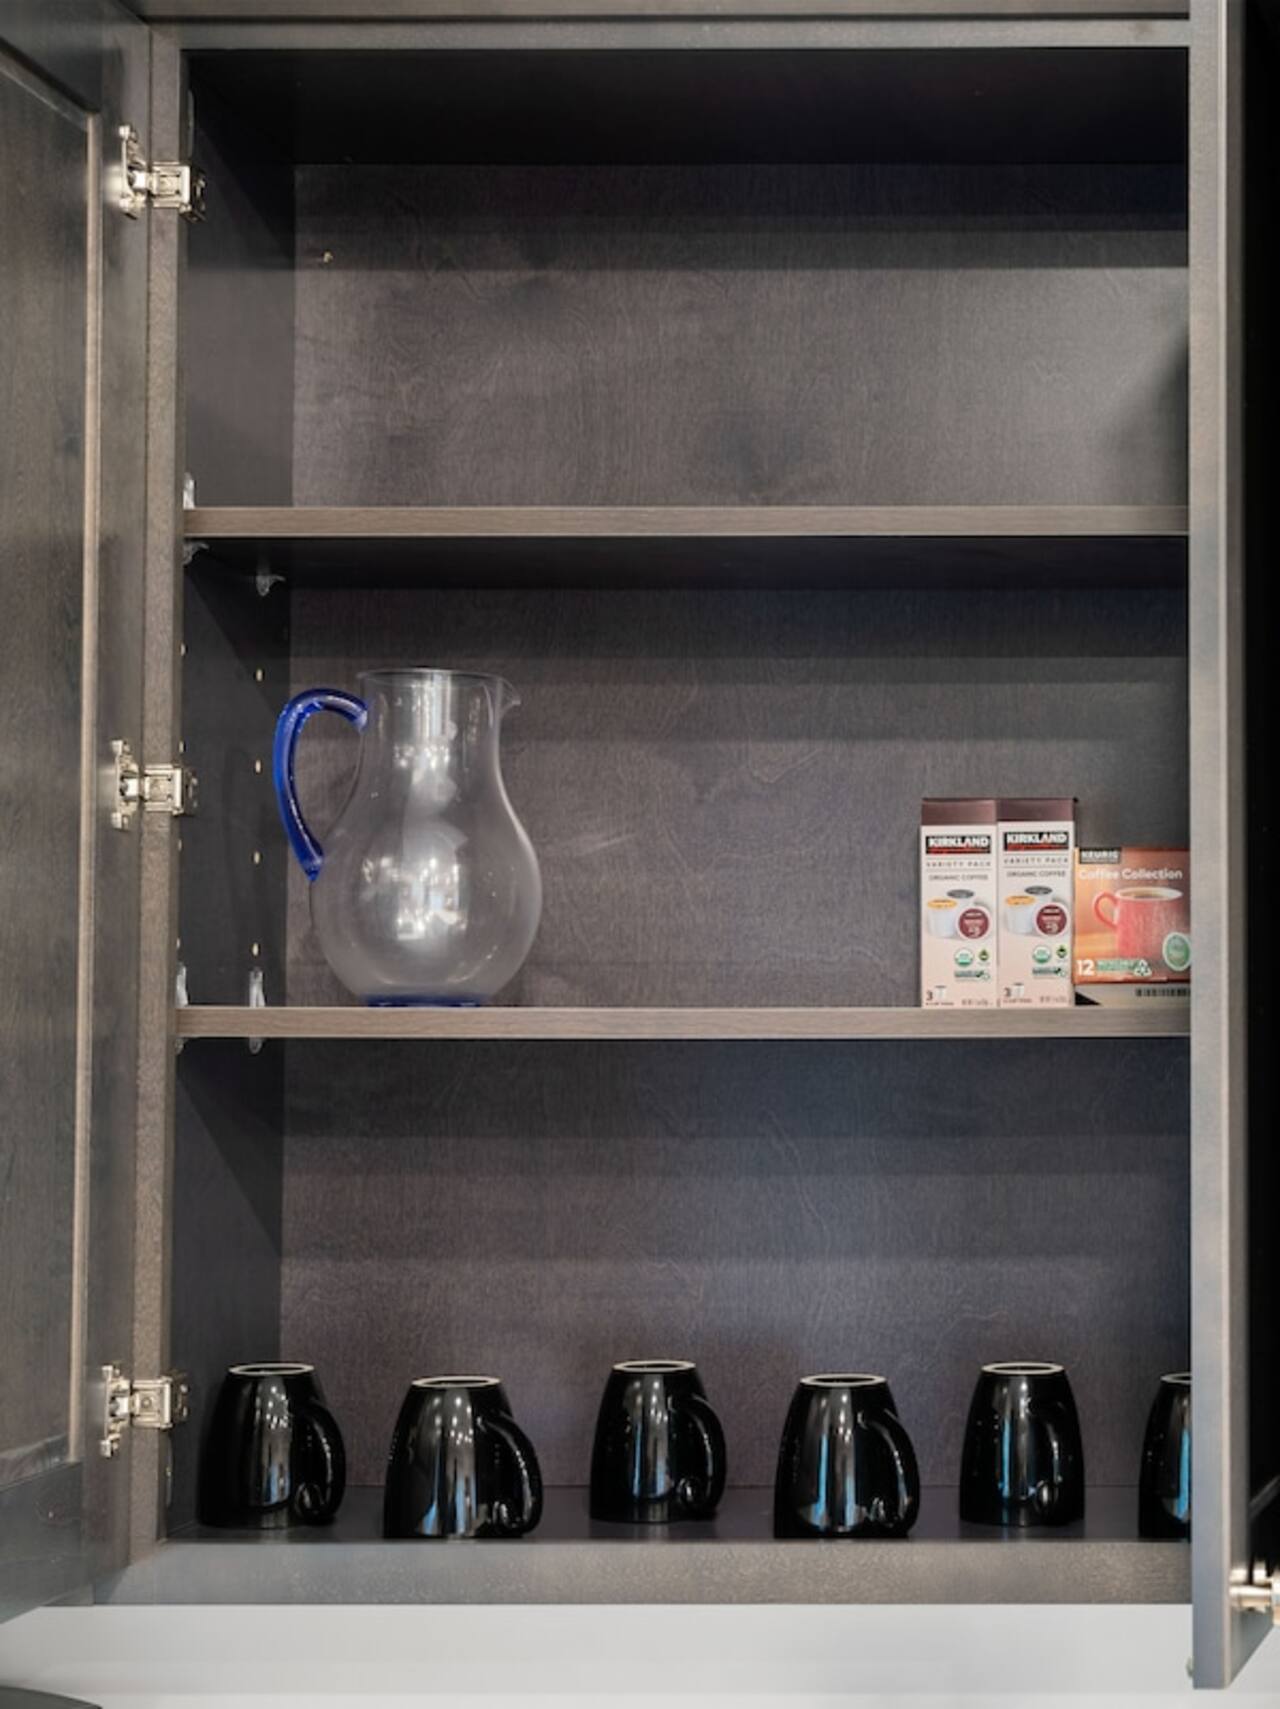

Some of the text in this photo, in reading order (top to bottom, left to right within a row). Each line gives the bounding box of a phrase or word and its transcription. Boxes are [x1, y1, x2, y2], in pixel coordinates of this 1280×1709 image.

[928, 837, 989, 847] KIRKLAND
[1006, 833, 1067, 844] KIRKLAND
[1081, 851, 1118, 859] KEURIG
[1080, 867, 1183, 880] Coffee Collection
[1077, 959, 1095, 976] 12
